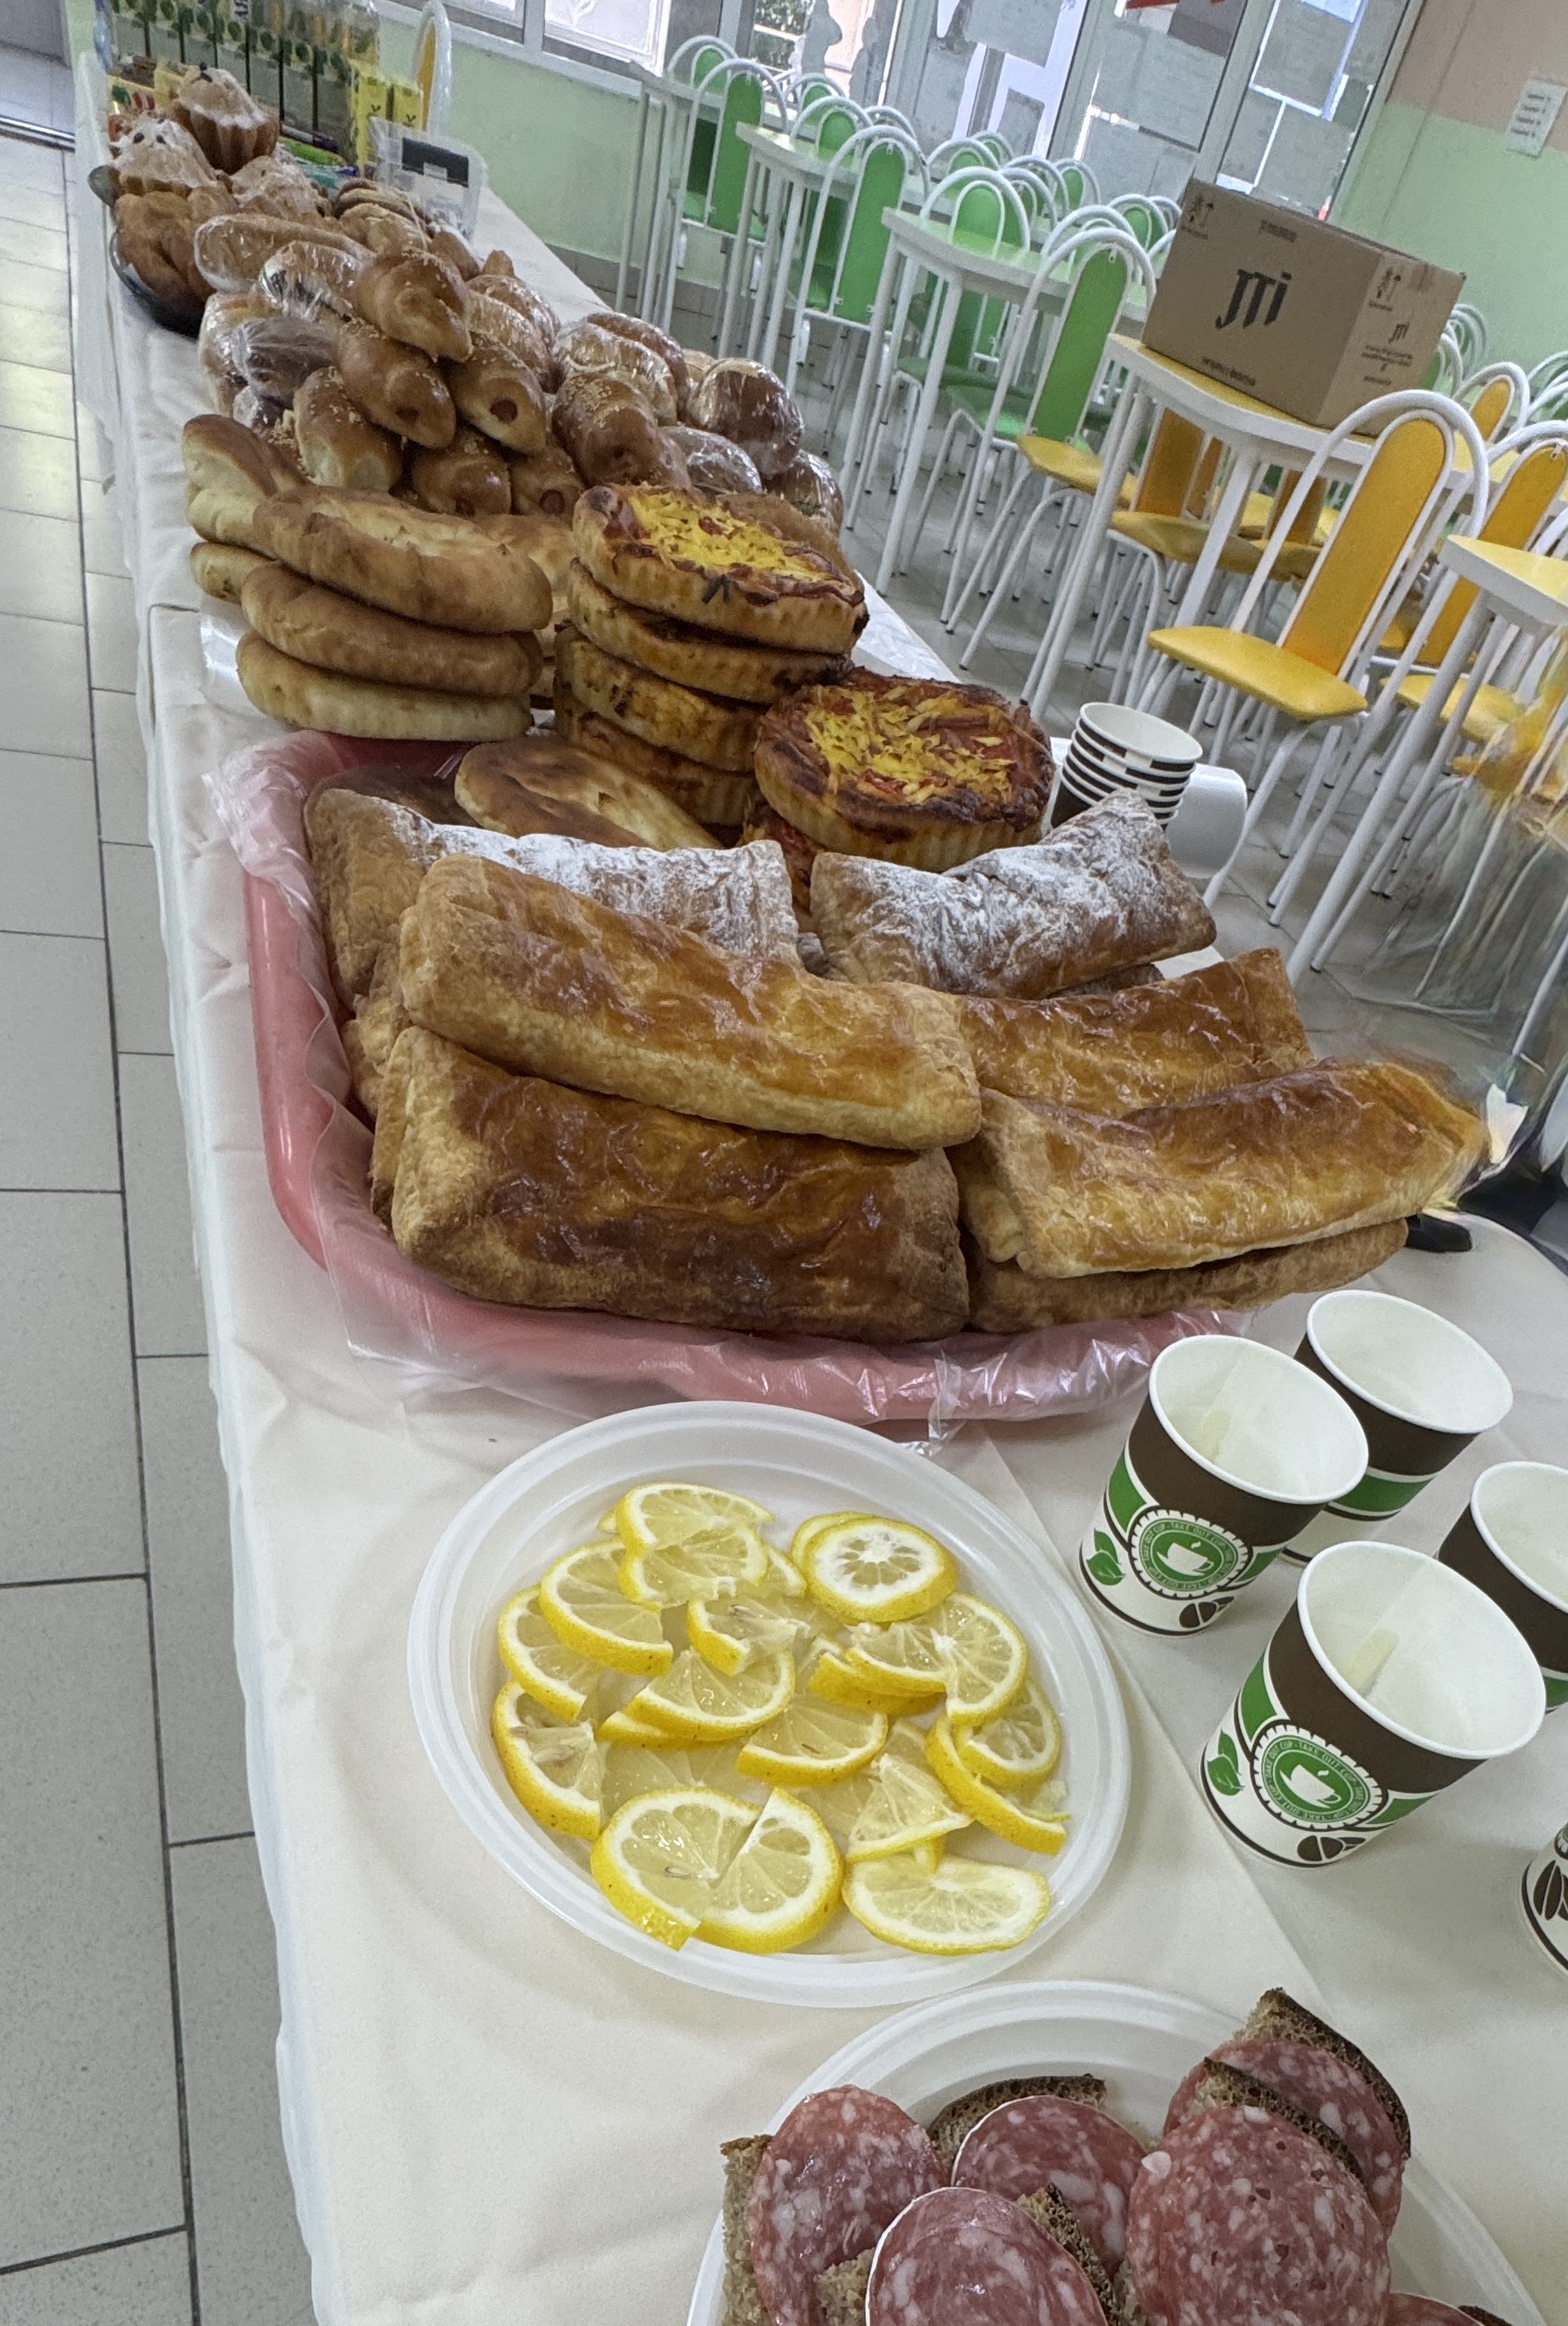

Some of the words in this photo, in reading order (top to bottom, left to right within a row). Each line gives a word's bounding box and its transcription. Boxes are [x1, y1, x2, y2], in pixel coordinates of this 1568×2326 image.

[1171, 1522, 1190, 1532] TAKE
[1194, 1528, 1209, 1537] OUT
[1298, 1741, 1319, 1756] TAKE
[1322, 1754, 1339, 1768] OUT
[1341, 1766, 1356, 1784] CUP
[1269, 1785, 1282, 1801] CUP
[1283, 1803, 1299, 1815] OUT
